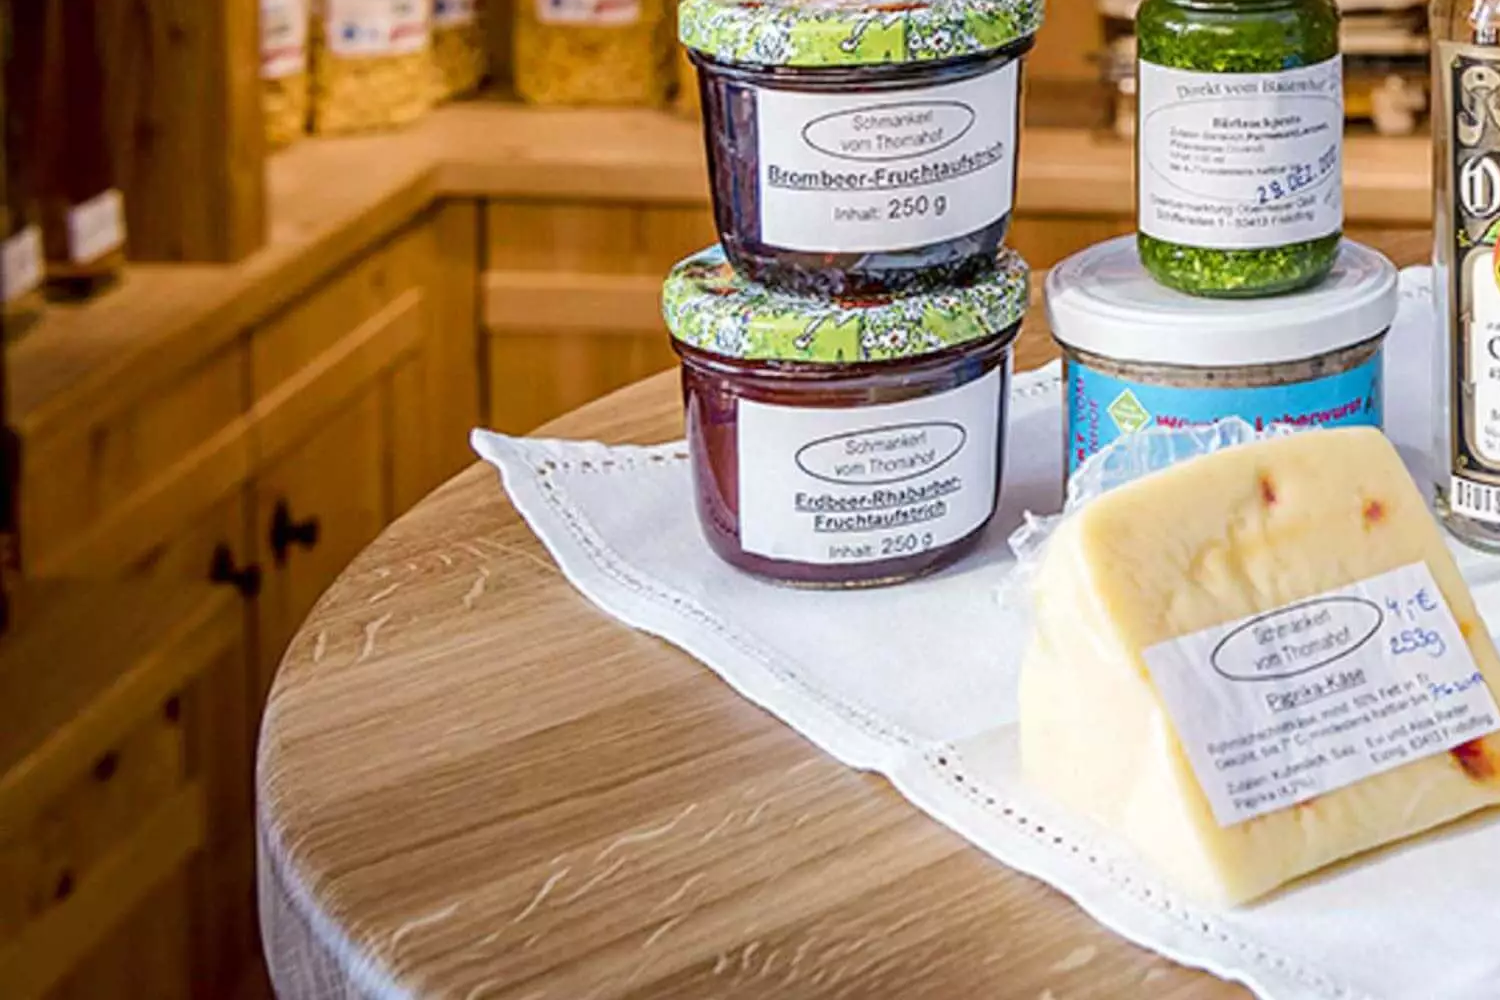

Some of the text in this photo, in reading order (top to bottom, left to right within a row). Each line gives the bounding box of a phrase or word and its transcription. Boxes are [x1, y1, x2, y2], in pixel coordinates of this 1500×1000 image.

[853, 110, 933, 131] Schmankerl
[841, 128, 944, 153] vom Thomahof
[768, 141, 1003, 189] Brombeer-Fruchtaufstrich
[887, 195, 930, 220] 250
[933, 195, 948, 218] g
[845, 430, 928, 455] Schmankerl
[834, 449, 936, 477] vom Thomahof
[813, 501, 946, 532] Fruchtaufstrich
[881, 534, 919, 556] 250
[921, 533, 934, 552] g
[1266, 669, 1367, 714] Paprika-Käse
